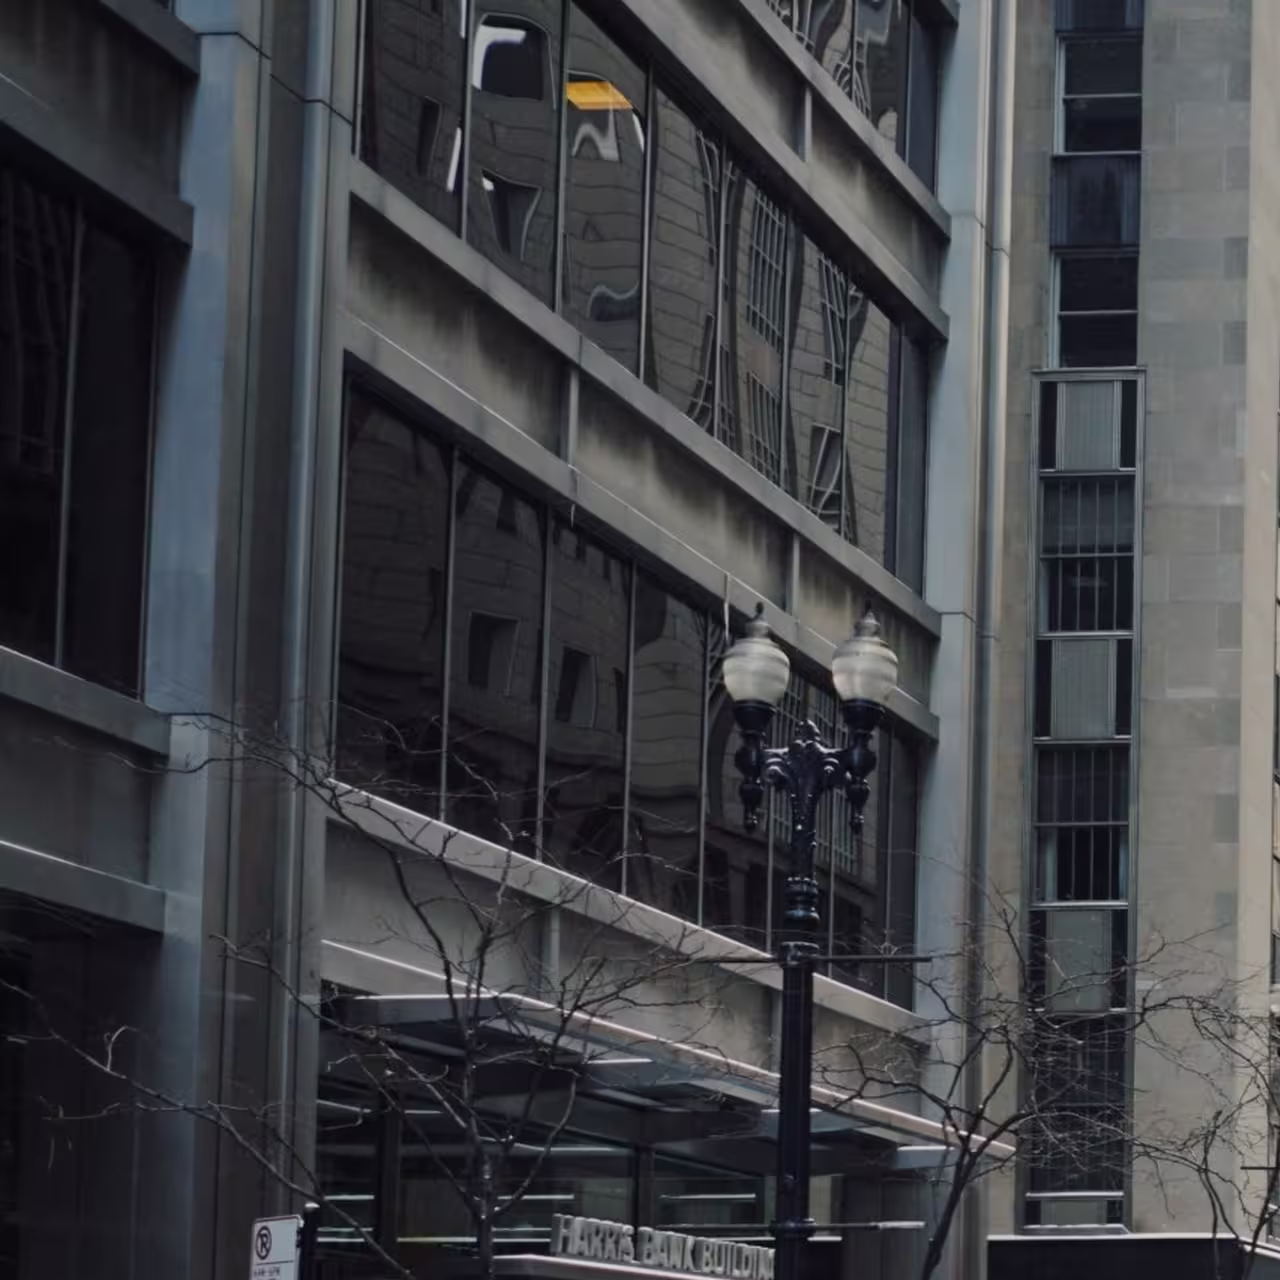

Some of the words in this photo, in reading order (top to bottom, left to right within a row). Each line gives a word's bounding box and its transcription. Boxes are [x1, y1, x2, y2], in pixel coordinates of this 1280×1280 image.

[554, 1214, 634, 1261] HARRIS
[642, 1227, 696, 1271] BANK
[702, 1237, 775, 1280] BUILDIN
